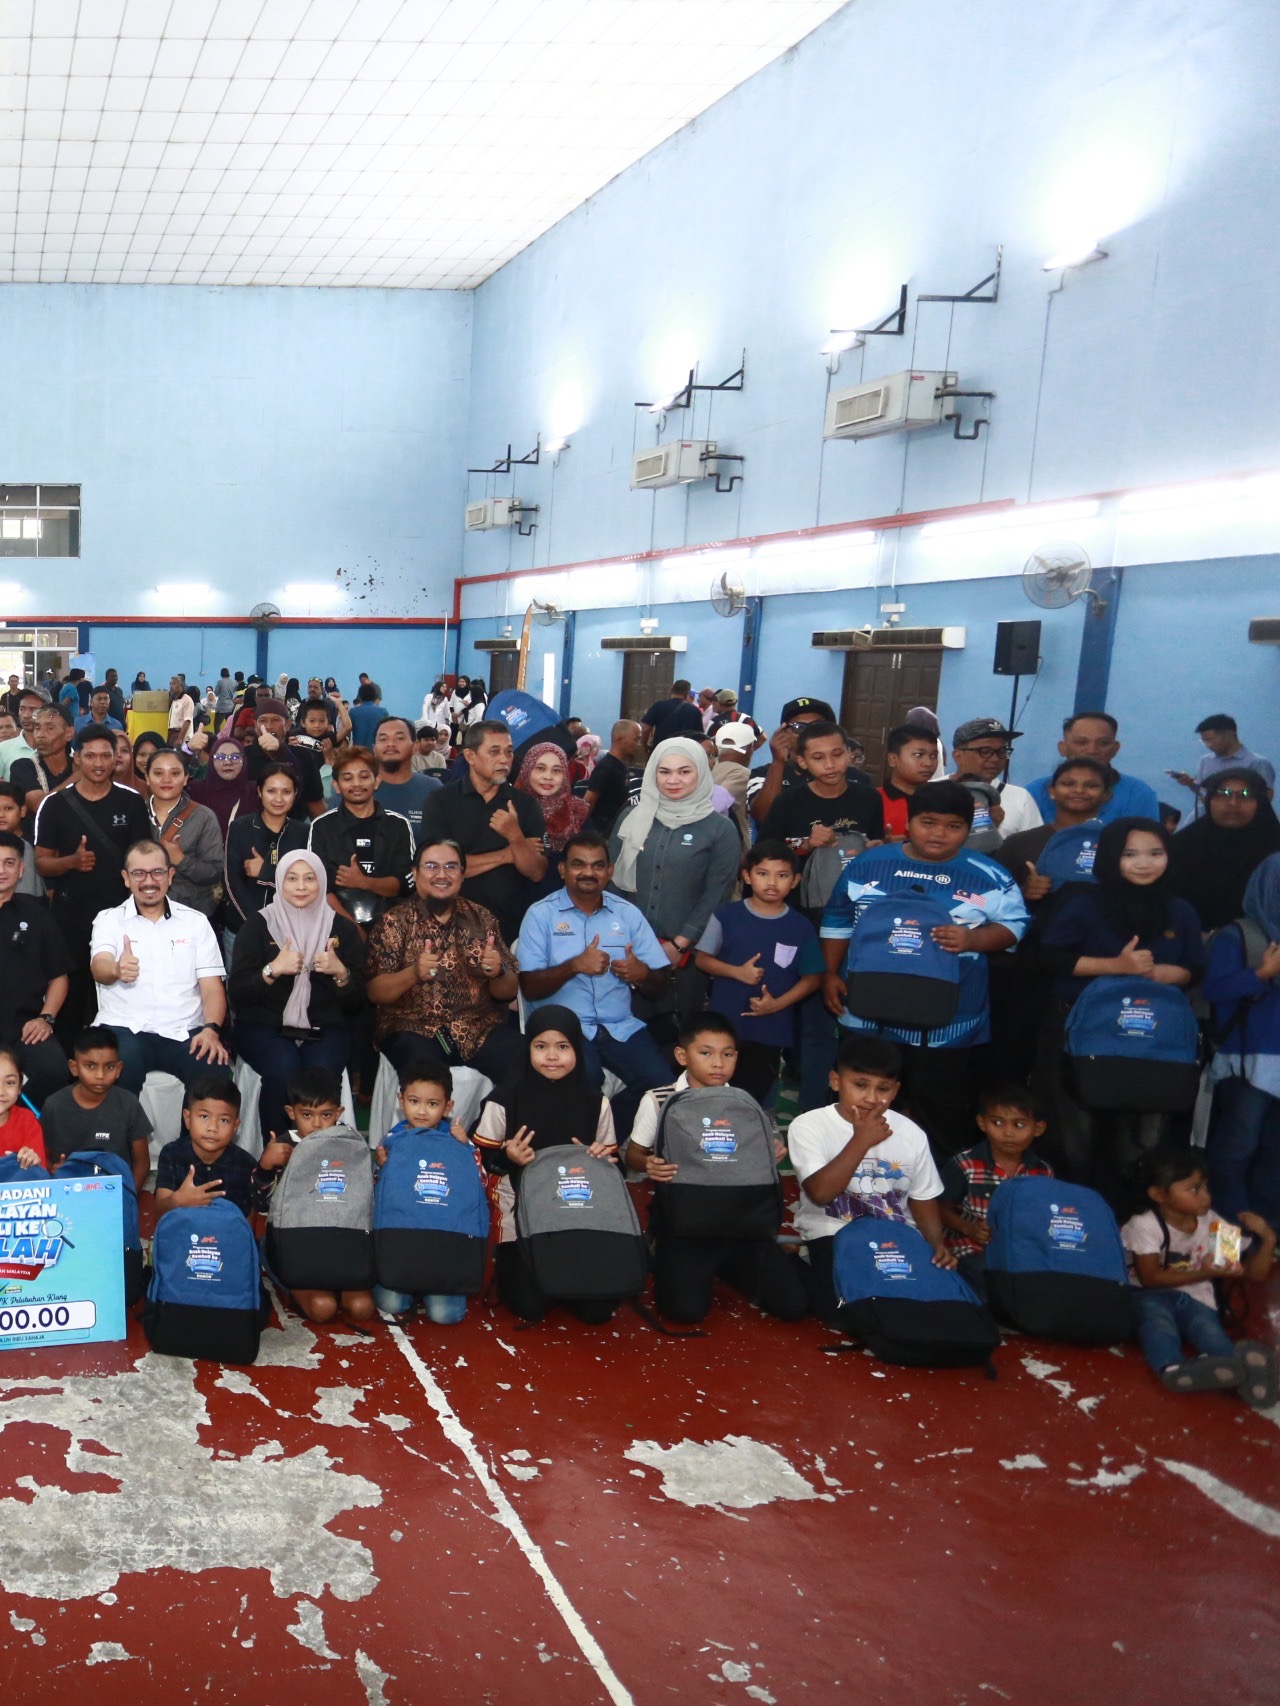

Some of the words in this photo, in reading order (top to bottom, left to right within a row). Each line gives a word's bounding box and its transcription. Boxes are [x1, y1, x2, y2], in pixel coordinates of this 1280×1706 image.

[894, 870, 933, 881] Allianz
[14, 1220, 40, 1237] KE
[6, 1269, 31, 1278] MALAYSIA
[46, 1293, 67, 1303] Klang
